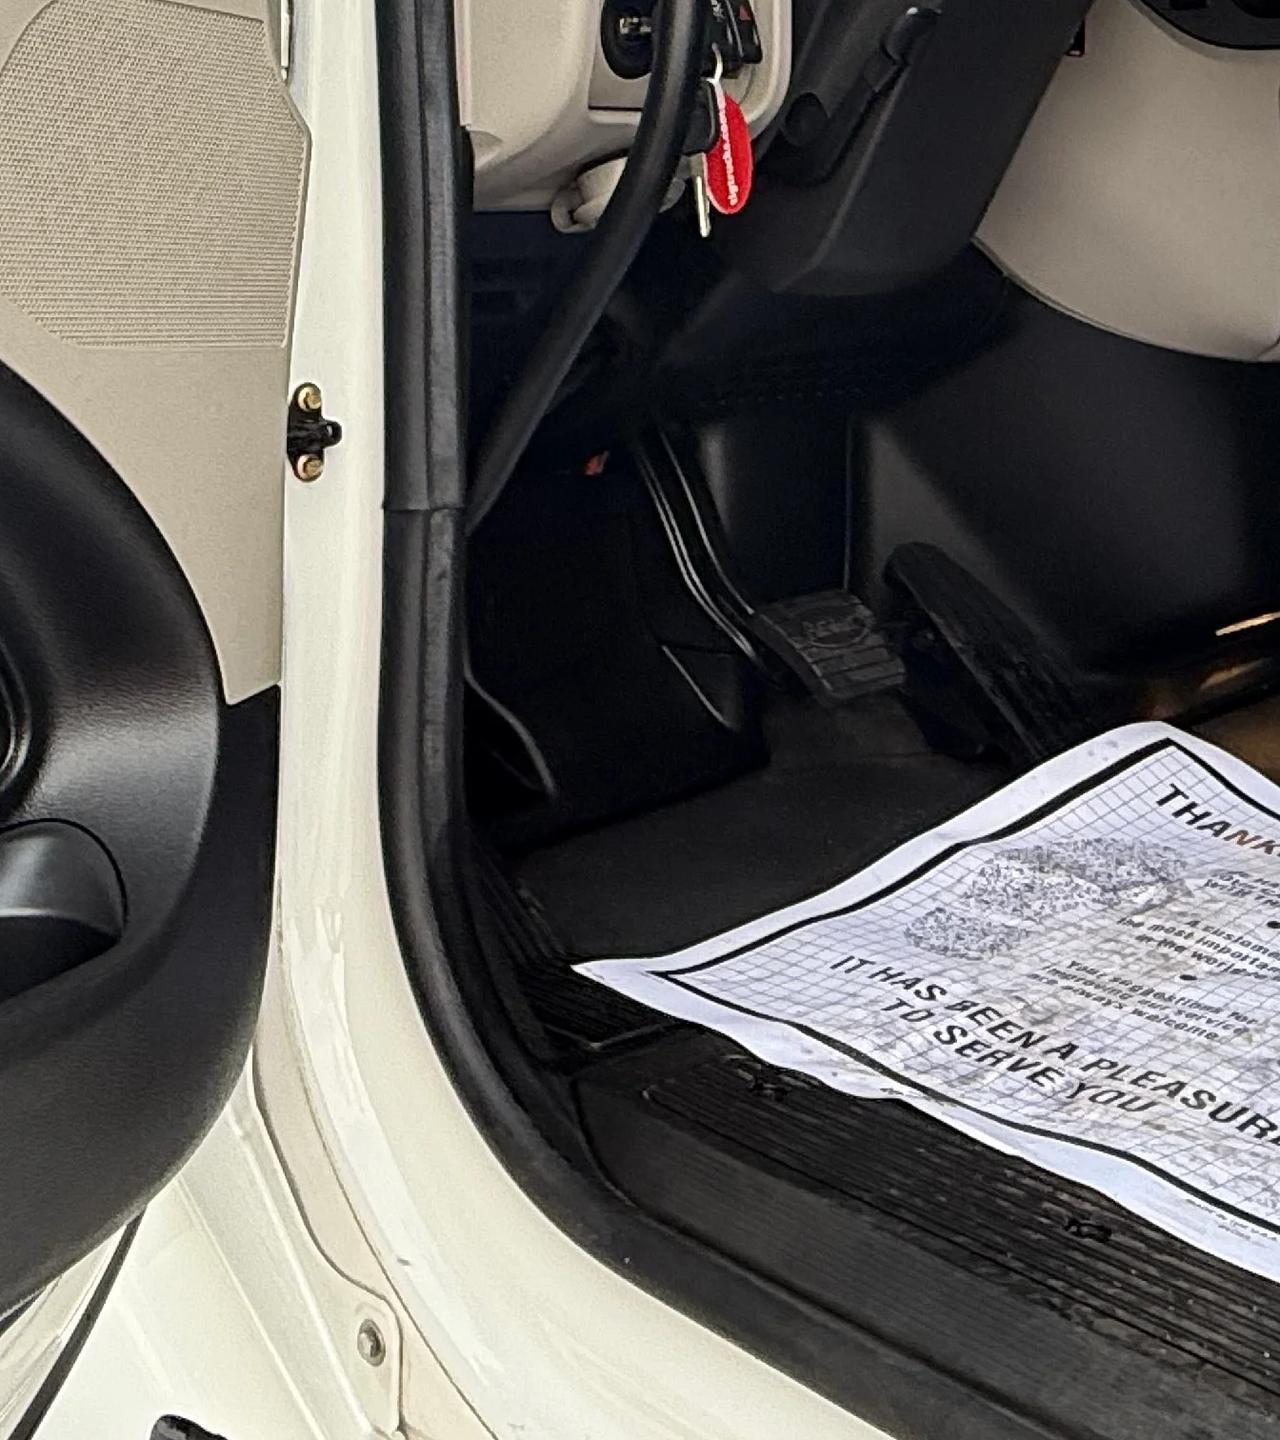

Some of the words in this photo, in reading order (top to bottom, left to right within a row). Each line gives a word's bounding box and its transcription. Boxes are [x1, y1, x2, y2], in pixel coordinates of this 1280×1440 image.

[1148, 924, 1194, 940] most
[830, 955, 876, 973] IT
[868, 966, 947, 1002] HAS
[944, 1000, 1049, 1048] BEEN
[1043, 1041, 1079, 1060] A
[880, 997, 935, 1022] TO
[933, 1025, 1065, 1088] SERVE
[1066, 1082, 1158, 1112] YOU
